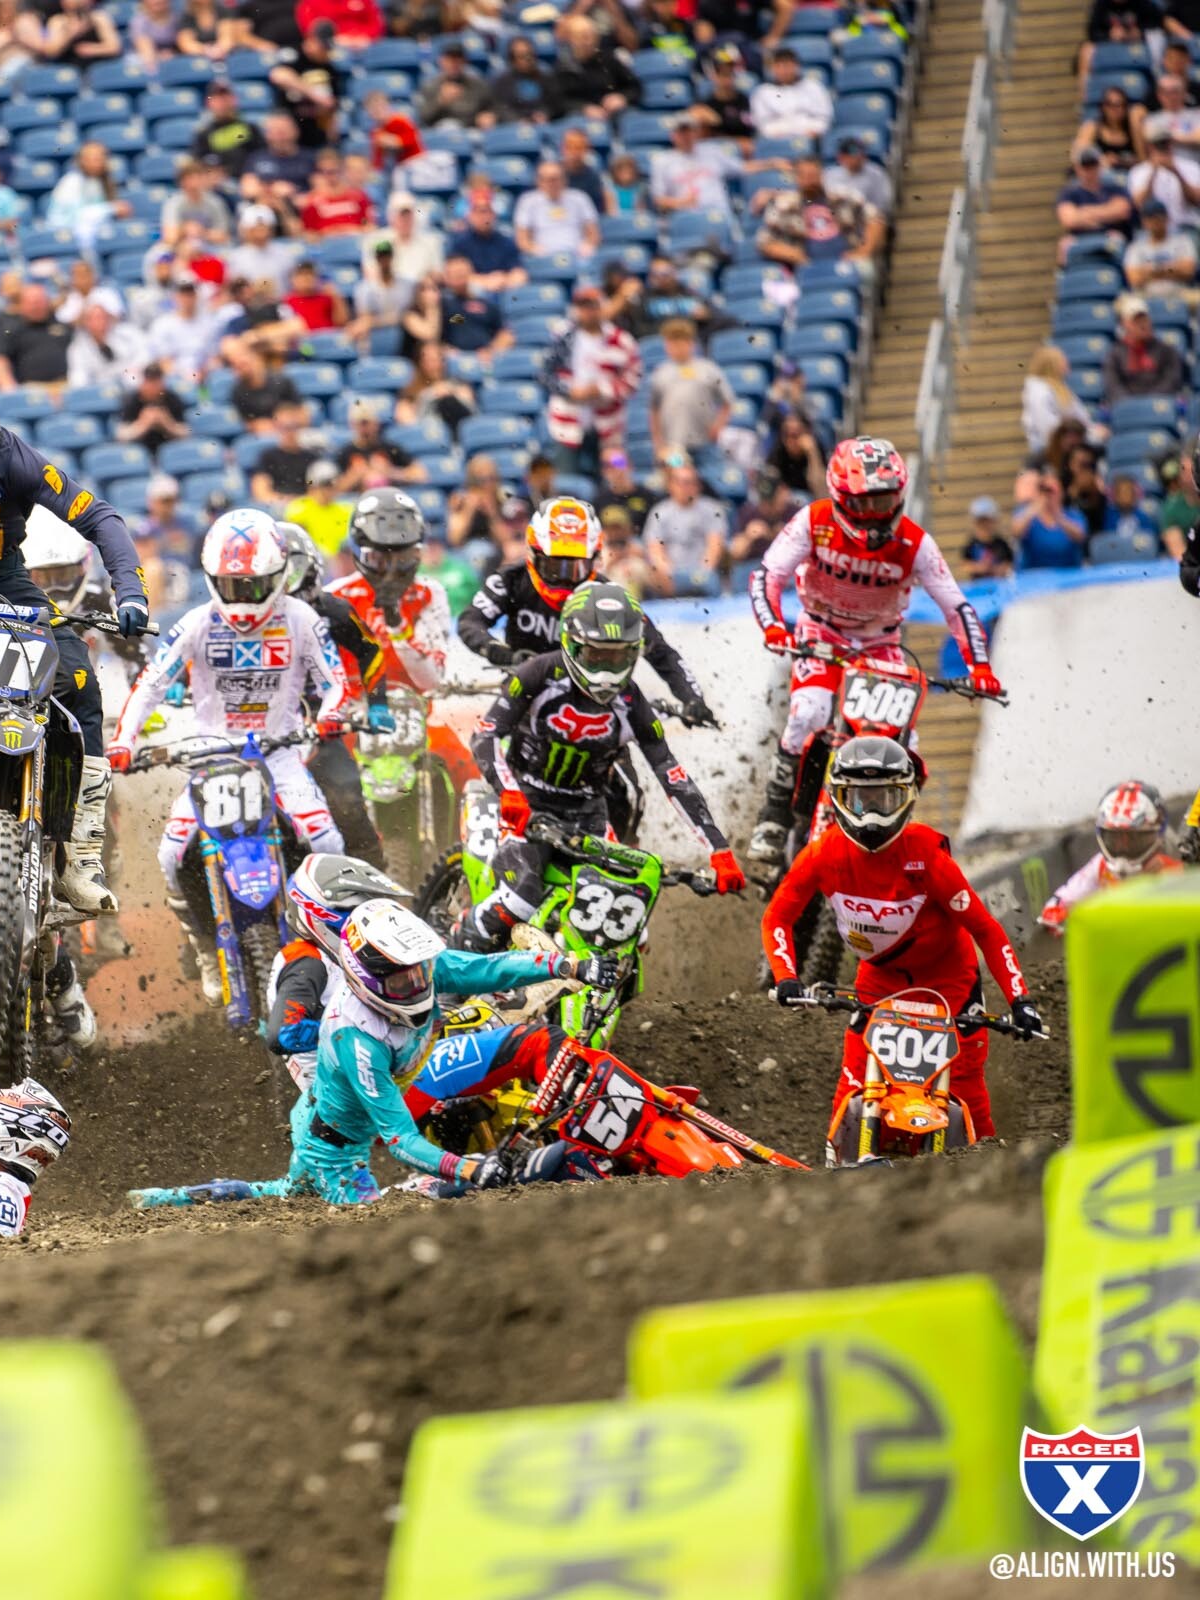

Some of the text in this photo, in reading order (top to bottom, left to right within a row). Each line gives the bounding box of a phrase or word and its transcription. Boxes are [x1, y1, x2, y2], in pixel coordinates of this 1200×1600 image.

[207, 640, 291, 669] FXR
[845, 676, 918, 727] 508
[203, 769, 263, 829] 81
[29, 841, 42, 914] DUNLOP
[568, 884, 647, 942] 33
[432, 1034, 470, 1072] FLY
[870, 1025, 951, 1072] 604
[583, 1072, 646, 1152] 54
